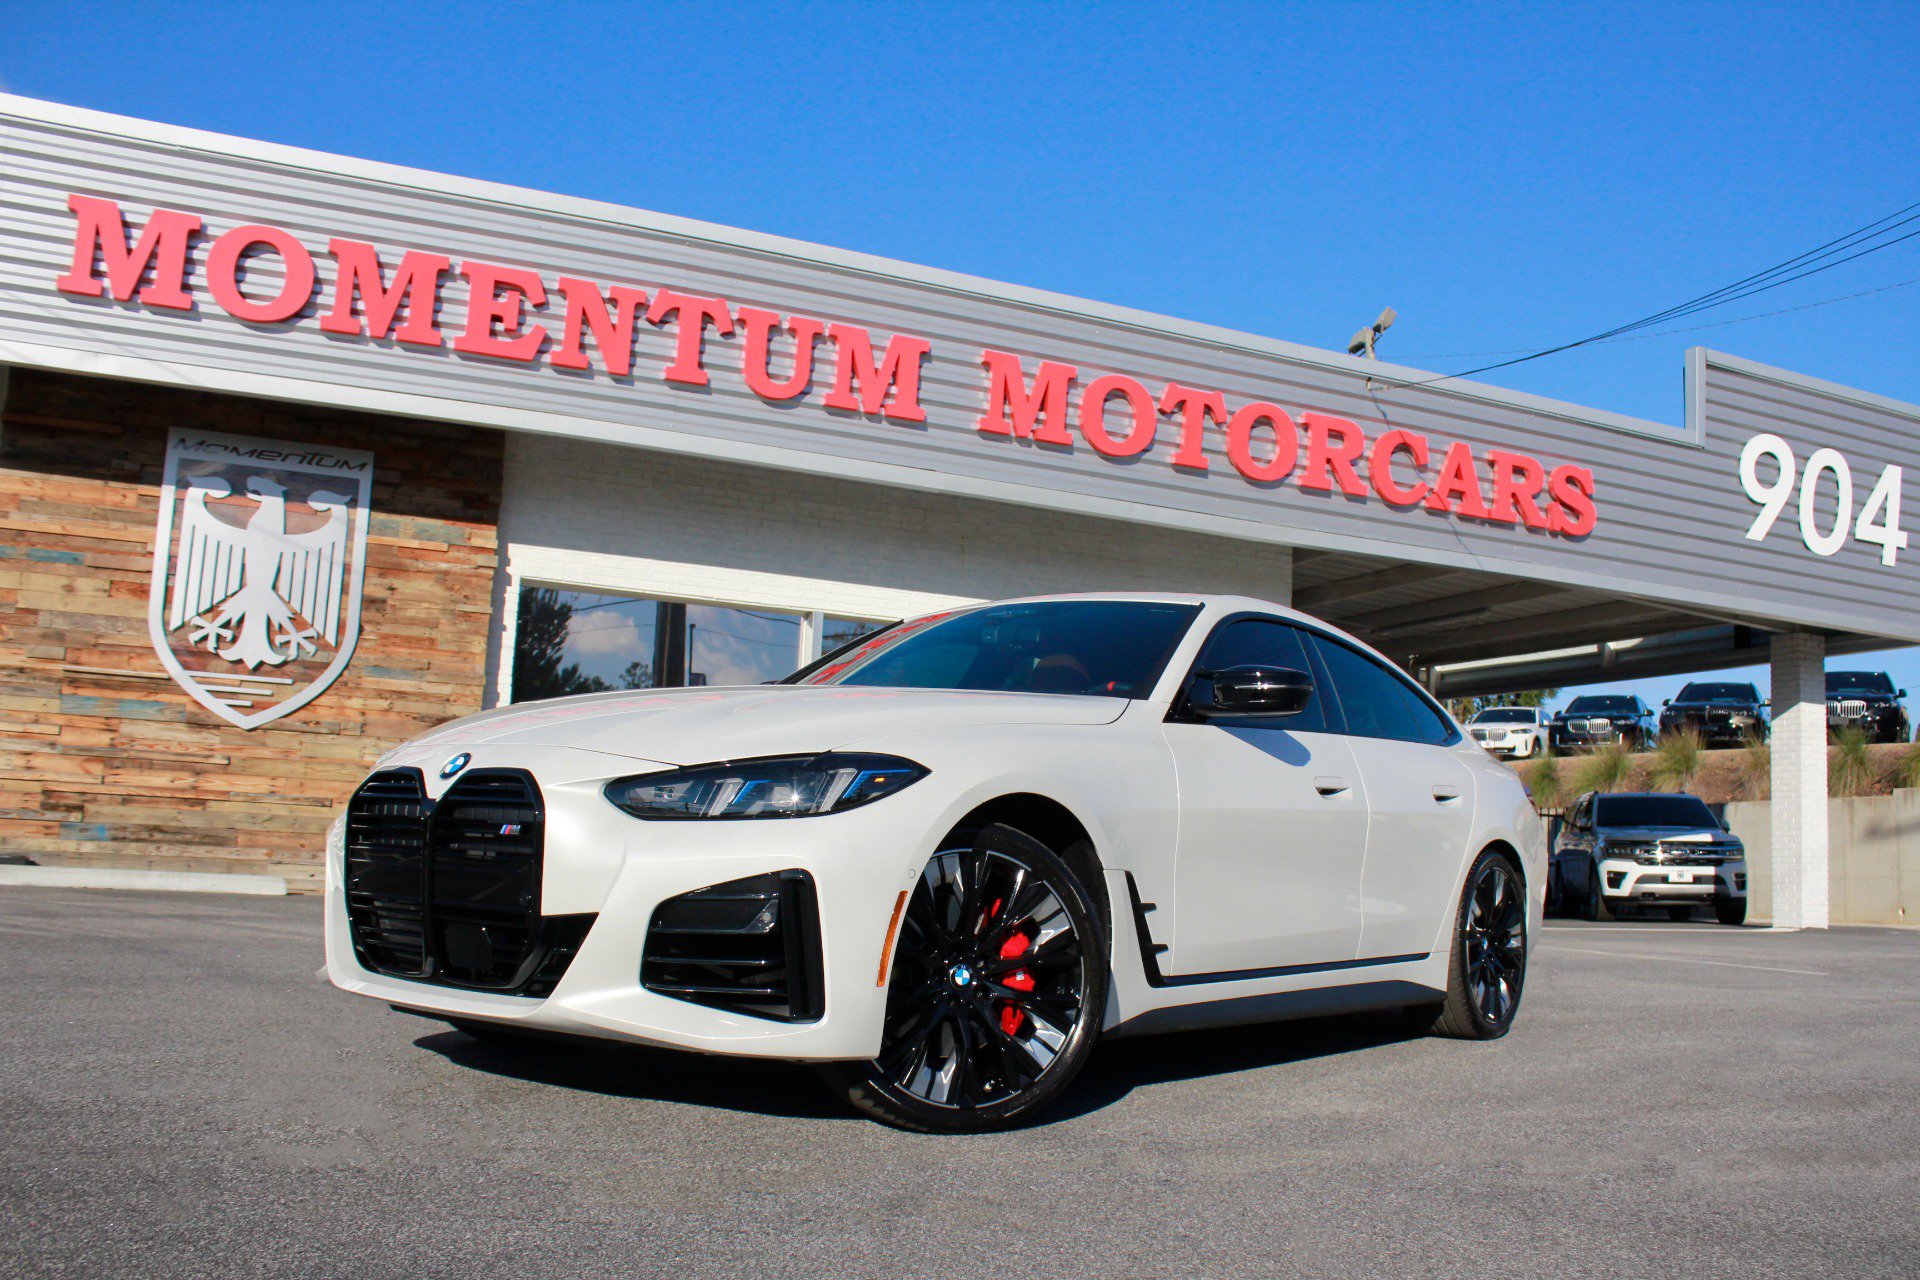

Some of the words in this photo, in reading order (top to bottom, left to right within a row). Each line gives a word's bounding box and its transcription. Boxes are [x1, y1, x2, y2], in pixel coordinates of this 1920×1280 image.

[57, 193, 930, 422] MOMENTUM
[977, 349, 1597, 536] MOTORCARS
[1739, 433, 1907, 567] 904
